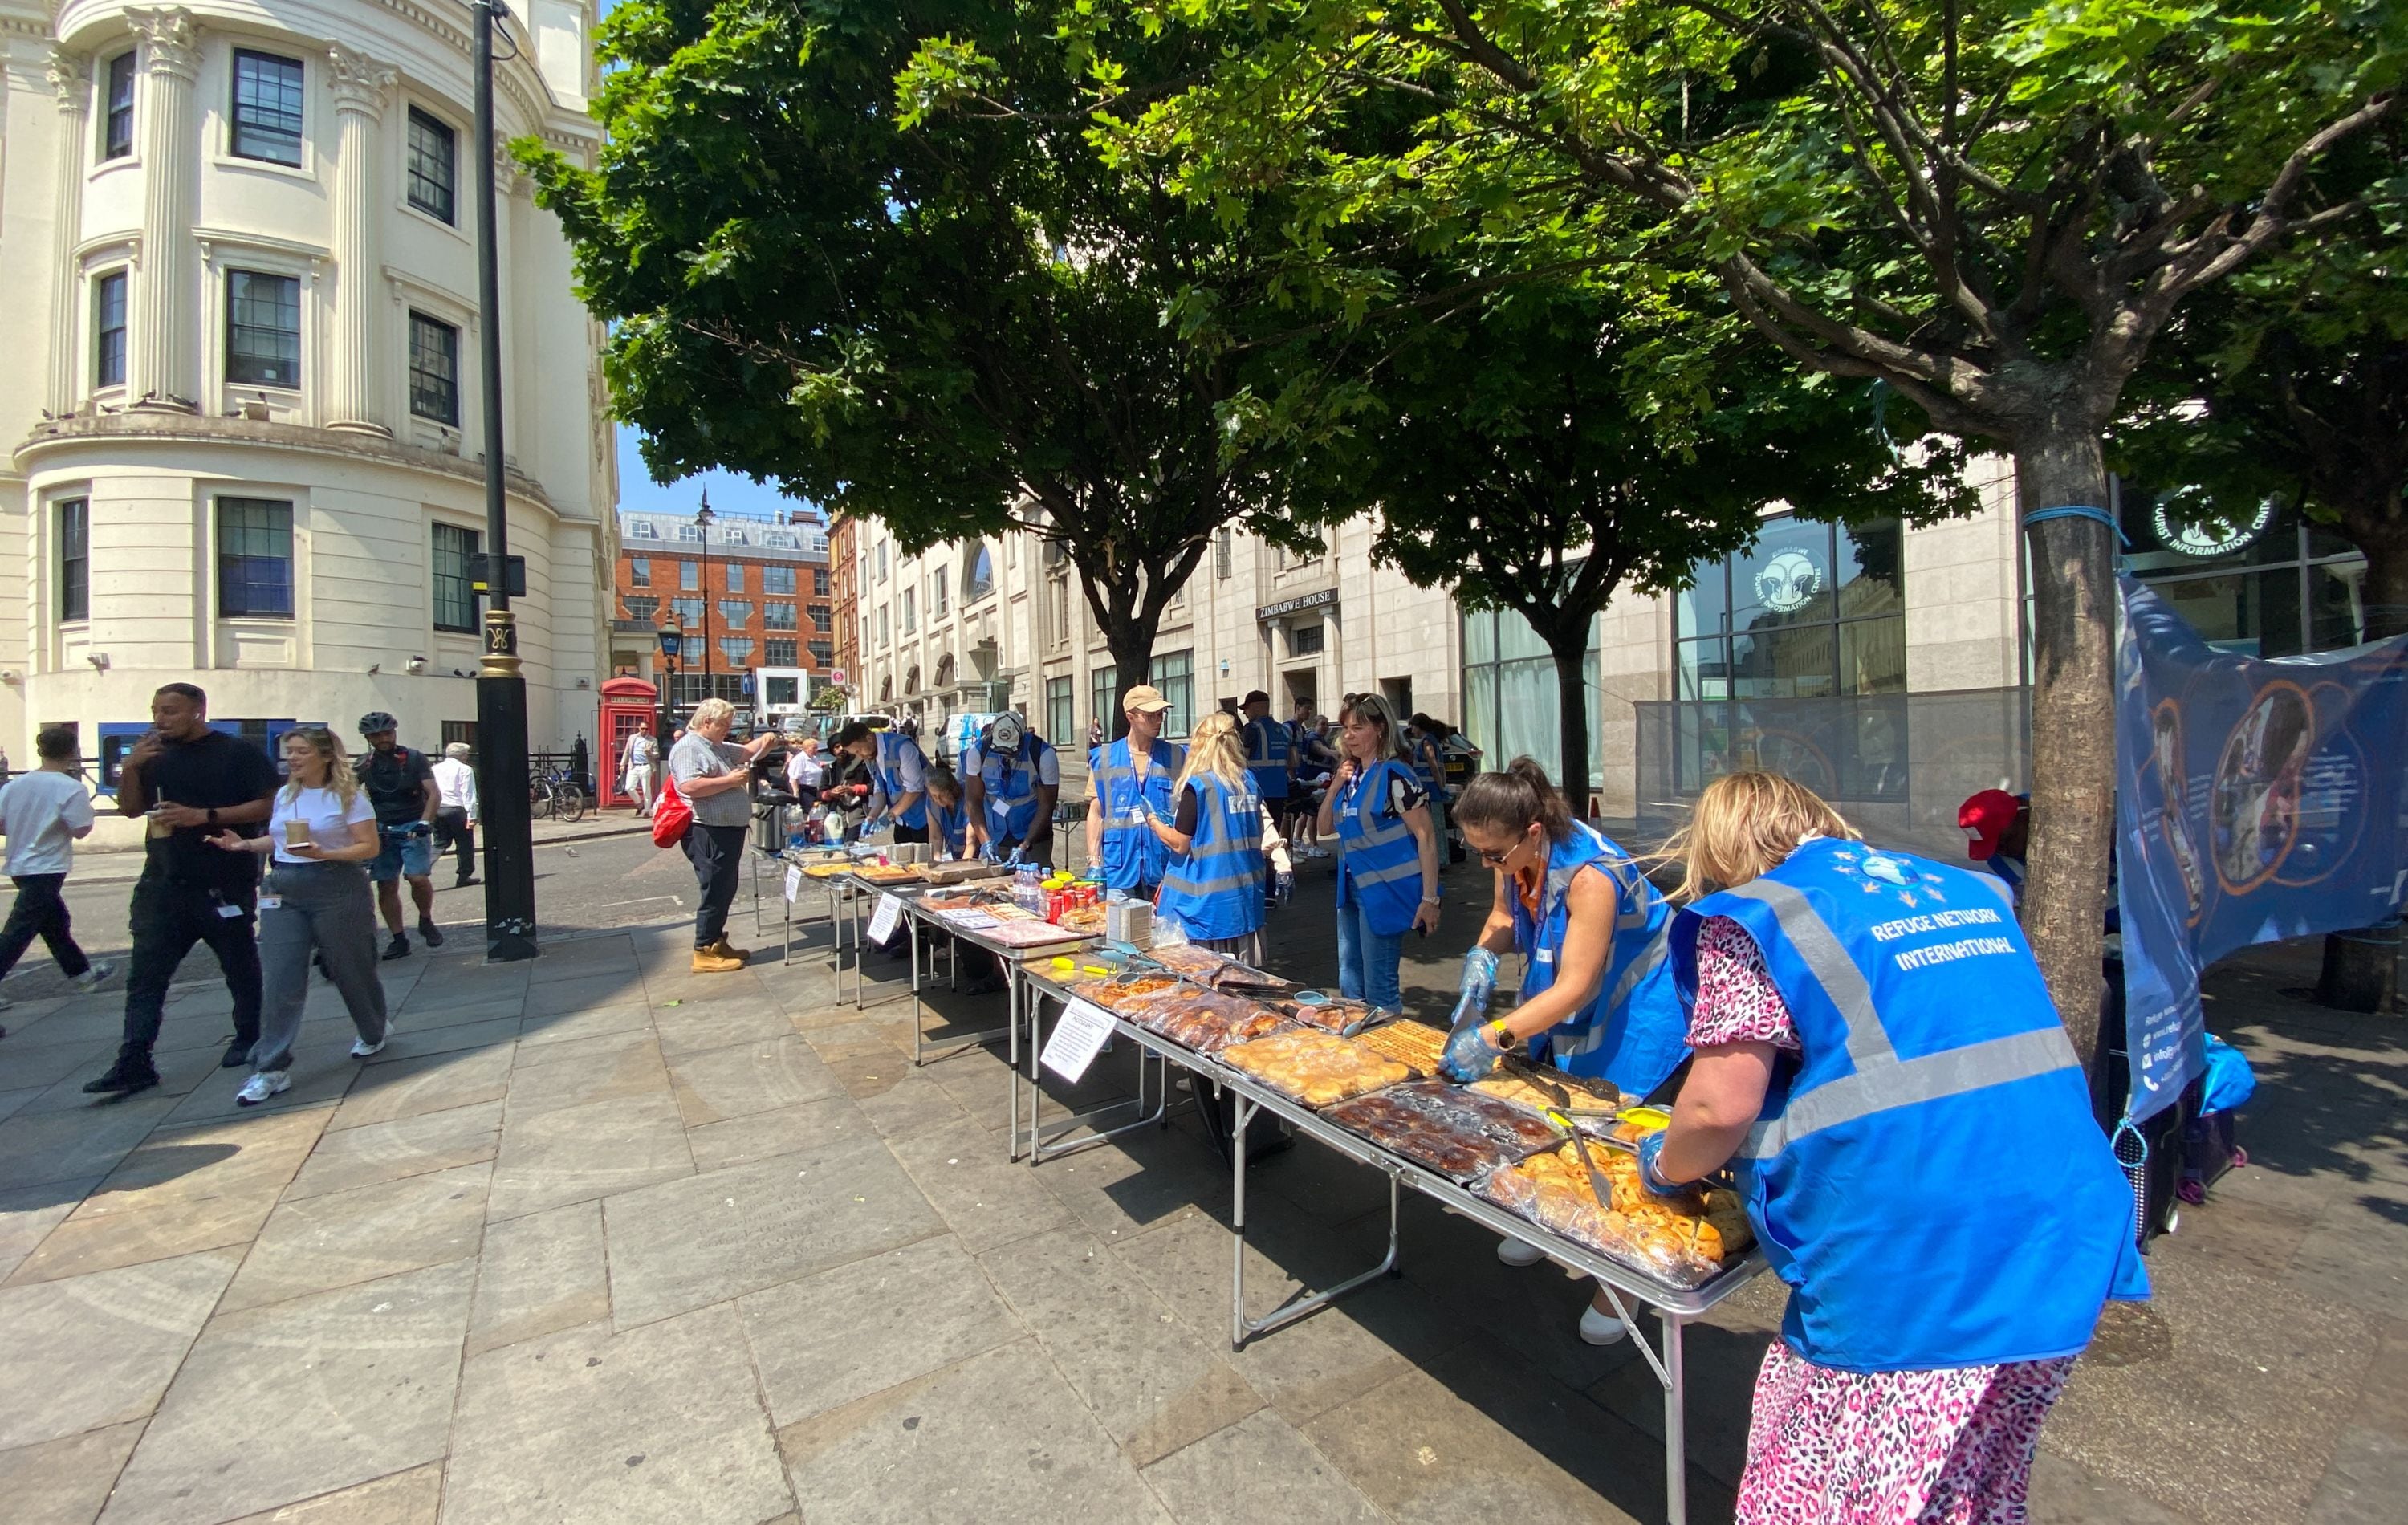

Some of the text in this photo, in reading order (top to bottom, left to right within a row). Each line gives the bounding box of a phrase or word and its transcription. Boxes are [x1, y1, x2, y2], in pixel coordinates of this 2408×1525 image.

[2169, 531, 2253, 555] INFORMATION
[2251, 496, 2271, 530] CENTR
[1260, 591, 1330, 617] ZIMBABWE HOUSE
[1755, 567, 1821, 612] TOURIST INFORMATION CENTRE
[1870, 909, 2002, 942] REFUGE NETWORK
[1894, 937, 2016, 971] INTERNATIONAL
